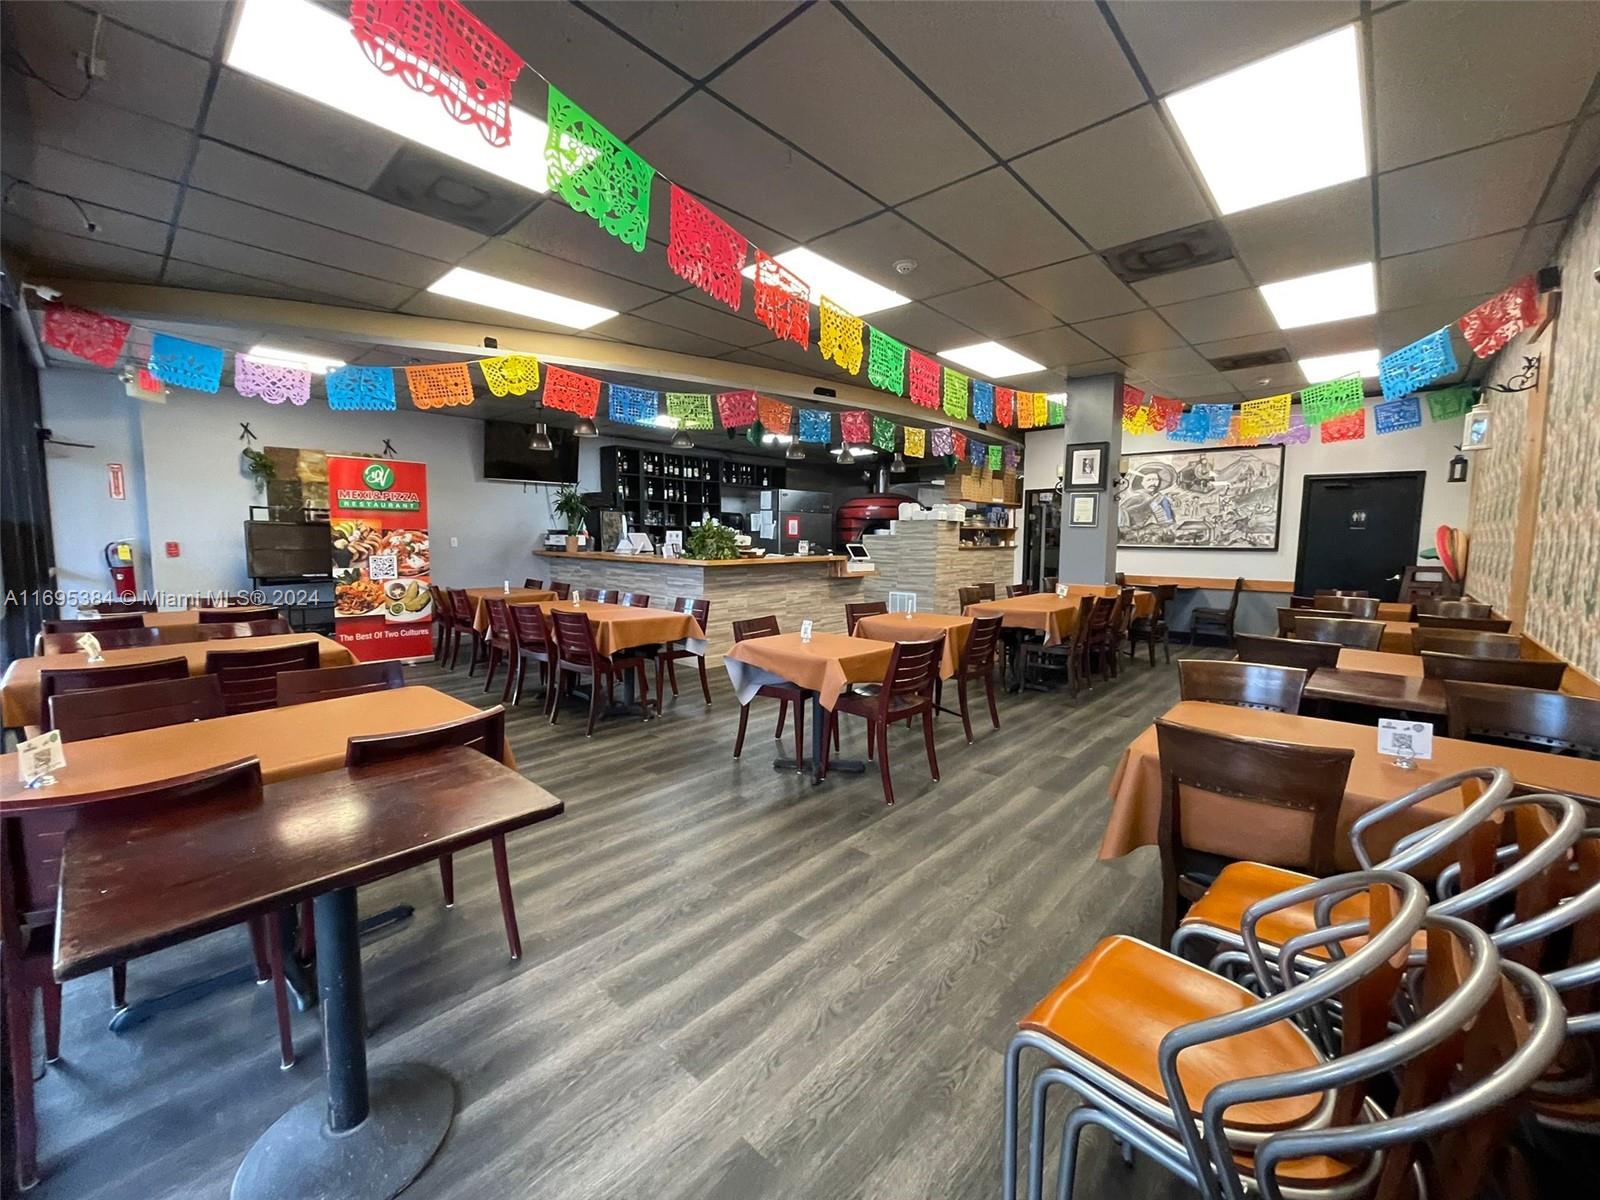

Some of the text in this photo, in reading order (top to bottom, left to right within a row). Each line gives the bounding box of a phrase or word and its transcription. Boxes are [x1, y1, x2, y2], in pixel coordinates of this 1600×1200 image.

[339, 628, 429, 642] The Best Of Two Cultures
